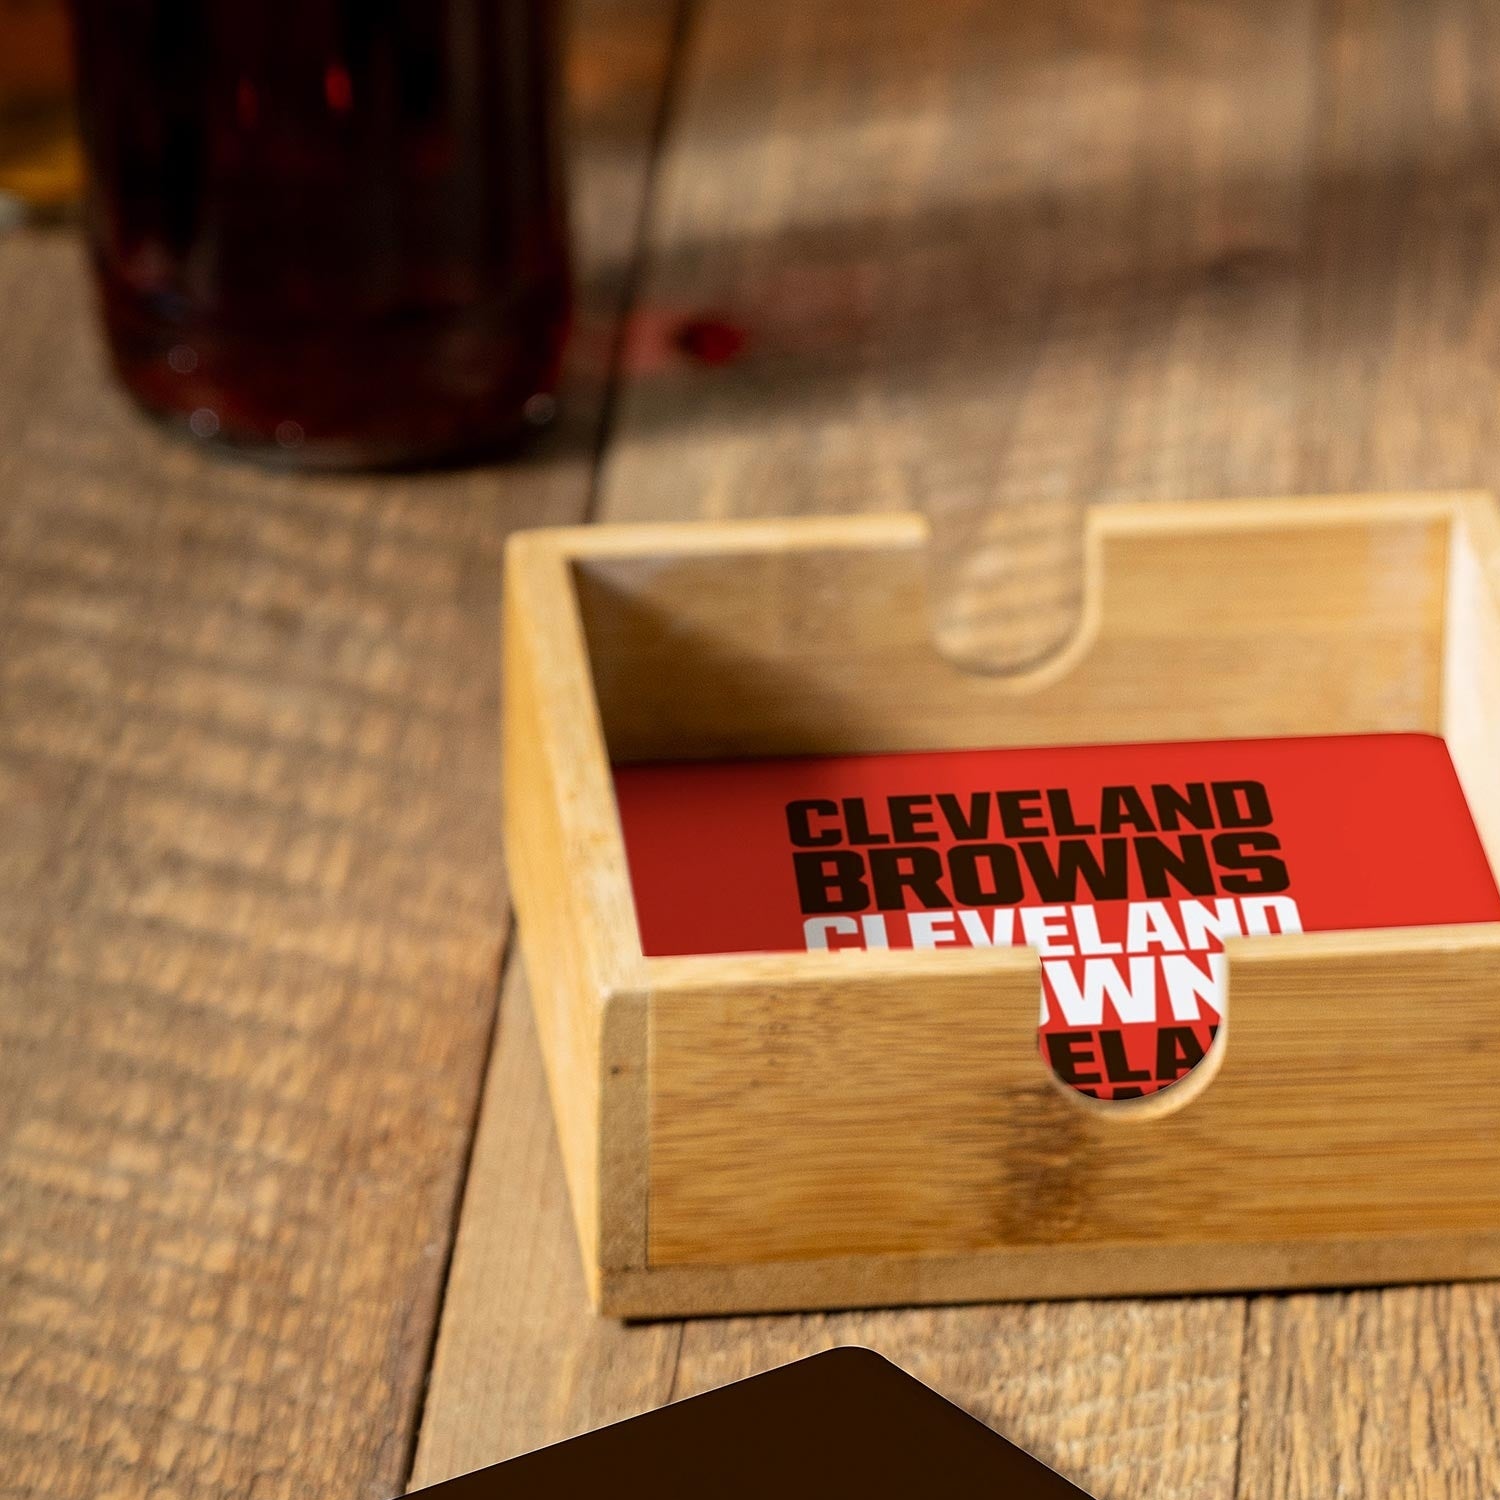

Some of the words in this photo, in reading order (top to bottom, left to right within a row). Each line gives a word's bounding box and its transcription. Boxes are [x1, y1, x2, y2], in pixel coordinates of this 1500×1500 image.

[785, 780, 1273, 847] CLEVELAND
[793, 831, 1290, 914] BROWNS
[803, 895, 1303, 957] CLEVELAND
